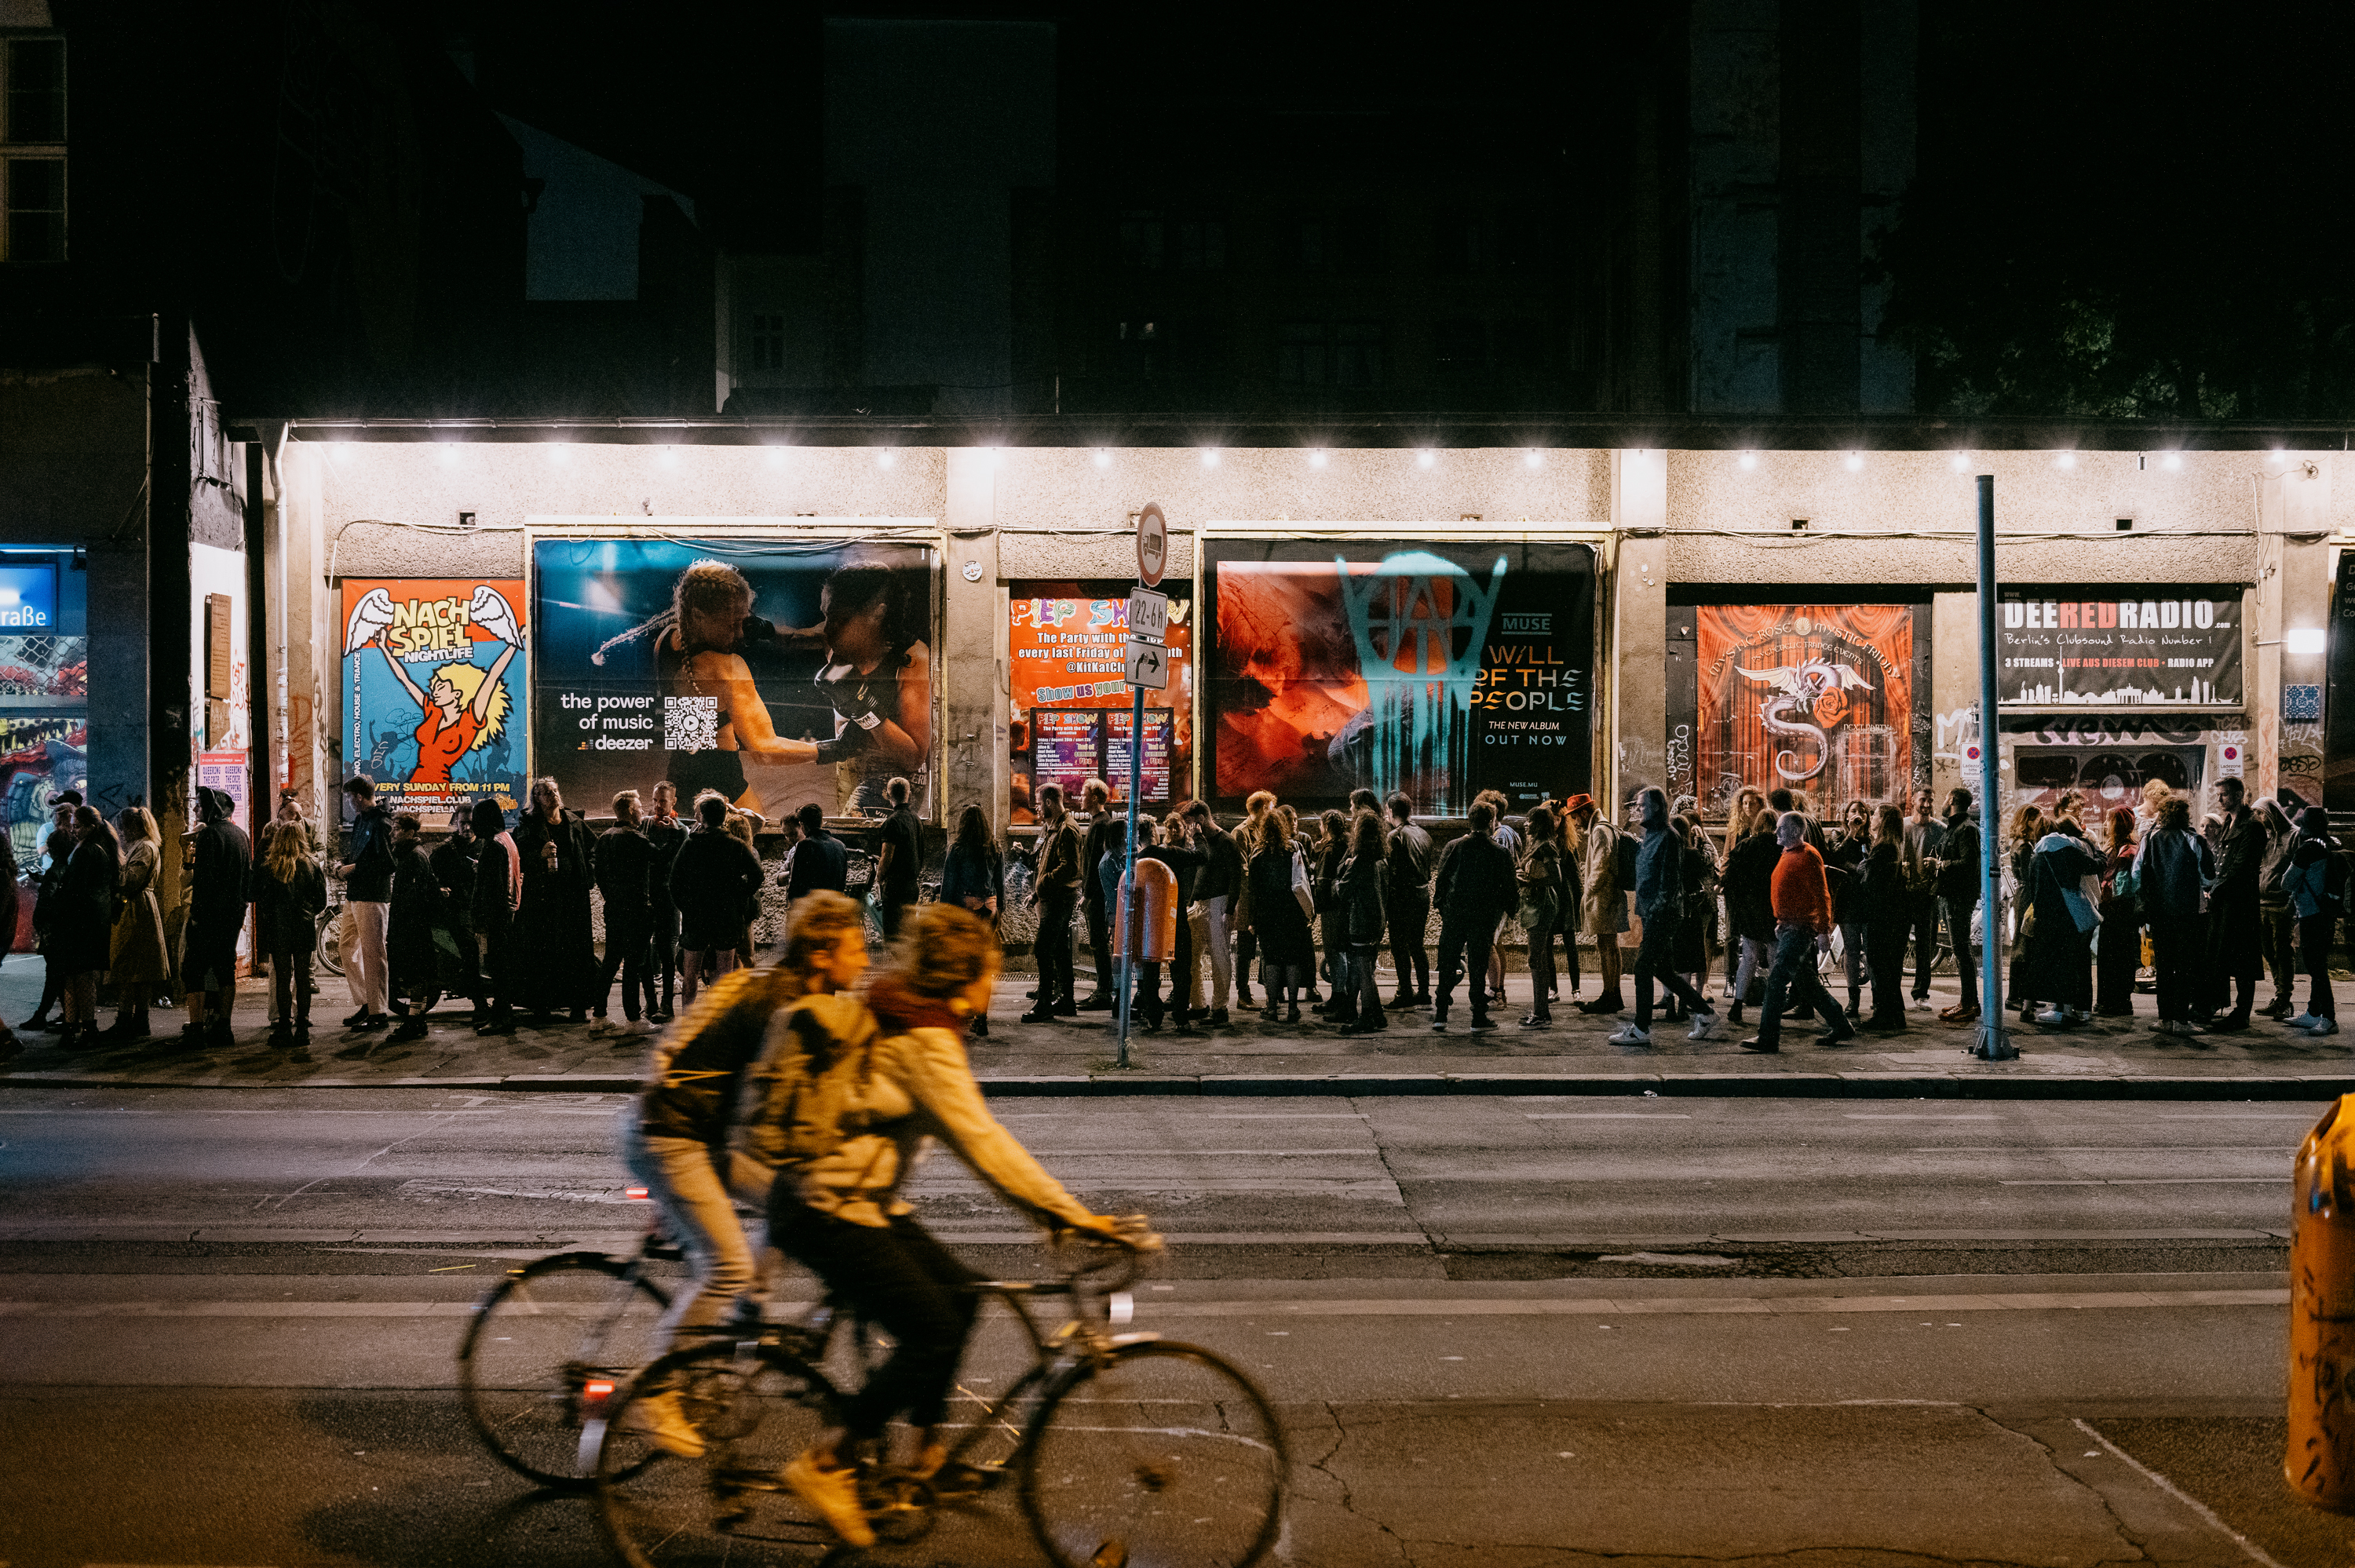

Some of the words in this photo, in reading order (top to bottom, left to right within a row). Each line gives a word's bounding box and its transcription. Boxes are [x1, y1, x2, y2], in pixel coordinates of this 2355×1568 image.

[393, 596, 470, 628] NACH
[1087, 599, 1189, 628] SHW
[1502, 617, 1550, 630] MUSE
[390, 622, 471, 656] SPIEL
[1037, 632, 1057, 644] The
[1060, 632, 1089, 644] Party
[1092, 632, 1115, 644] with
[2004, 633, 2050, 645] Berlin's
[2057, 633, 2113, 645] Clubsound
[2120, 634, 2155, 644] Radio
[2161, 634, 2203, 645] Number
[404, 647, 473, 662] NIGHTLIFE
[1018, 648, 1050, 659] every
[1052, 647, 1073, 658] last
[1076, 647, 1110, 659] Friday
[1113, 647, 1124, 658] of
[1488, 645, 1564, 665] WILL
[1805, 641, 1832, 651] TRANCE
[1834, 646, 1863, 665] EVENTS
[1066, 662, 1125, 673] @KitKatClu
[2005, 658, 2011, 667] 3
[2014, 658, 2054, 667] STREAMS
[2062, 658, 2080, 667] LIVE
[2083, 658, 2100, 667] AUS
[2102, 658, 2135, 667] DIESEM
[2137, 658, 2160, 667] CLUB
[2167, 658, 2195, 667] RADIO
[2196, 658, 2214, 667] APP
[1516, 669, 1583, 687] THE
[1037, 687, 1073, 702] Show
[1076, 684, 1093, 697] us
[560, 692, 592, 709] the
[597, 696, 655, 712] power
[1469, 691, 1583, 711] PEOPLE
[579, 713, 598, 730] of
[603, 714, 654, 730] music
[1143, 713, 1168, 724] HOW
[1488, 720, 1506, 730] THE
[1507, 721, 1528, 730] NEW
[1529, 721, 1560, 730] ALBUM
[353, 720, 362, 758] ELECTRO,
[595, 735, 653, 750] deezer
[1485, 735, 1520, 745] OUT
[1529, 735, 1567, 746] NOW
[374, 782, 400, 792] VERY
[403, 782, 447, 792] SUNDAY
[449, 782, 479, 792] FROM
[480, 783, 491, 792] 11
[494, 783, 510, 792] PM
